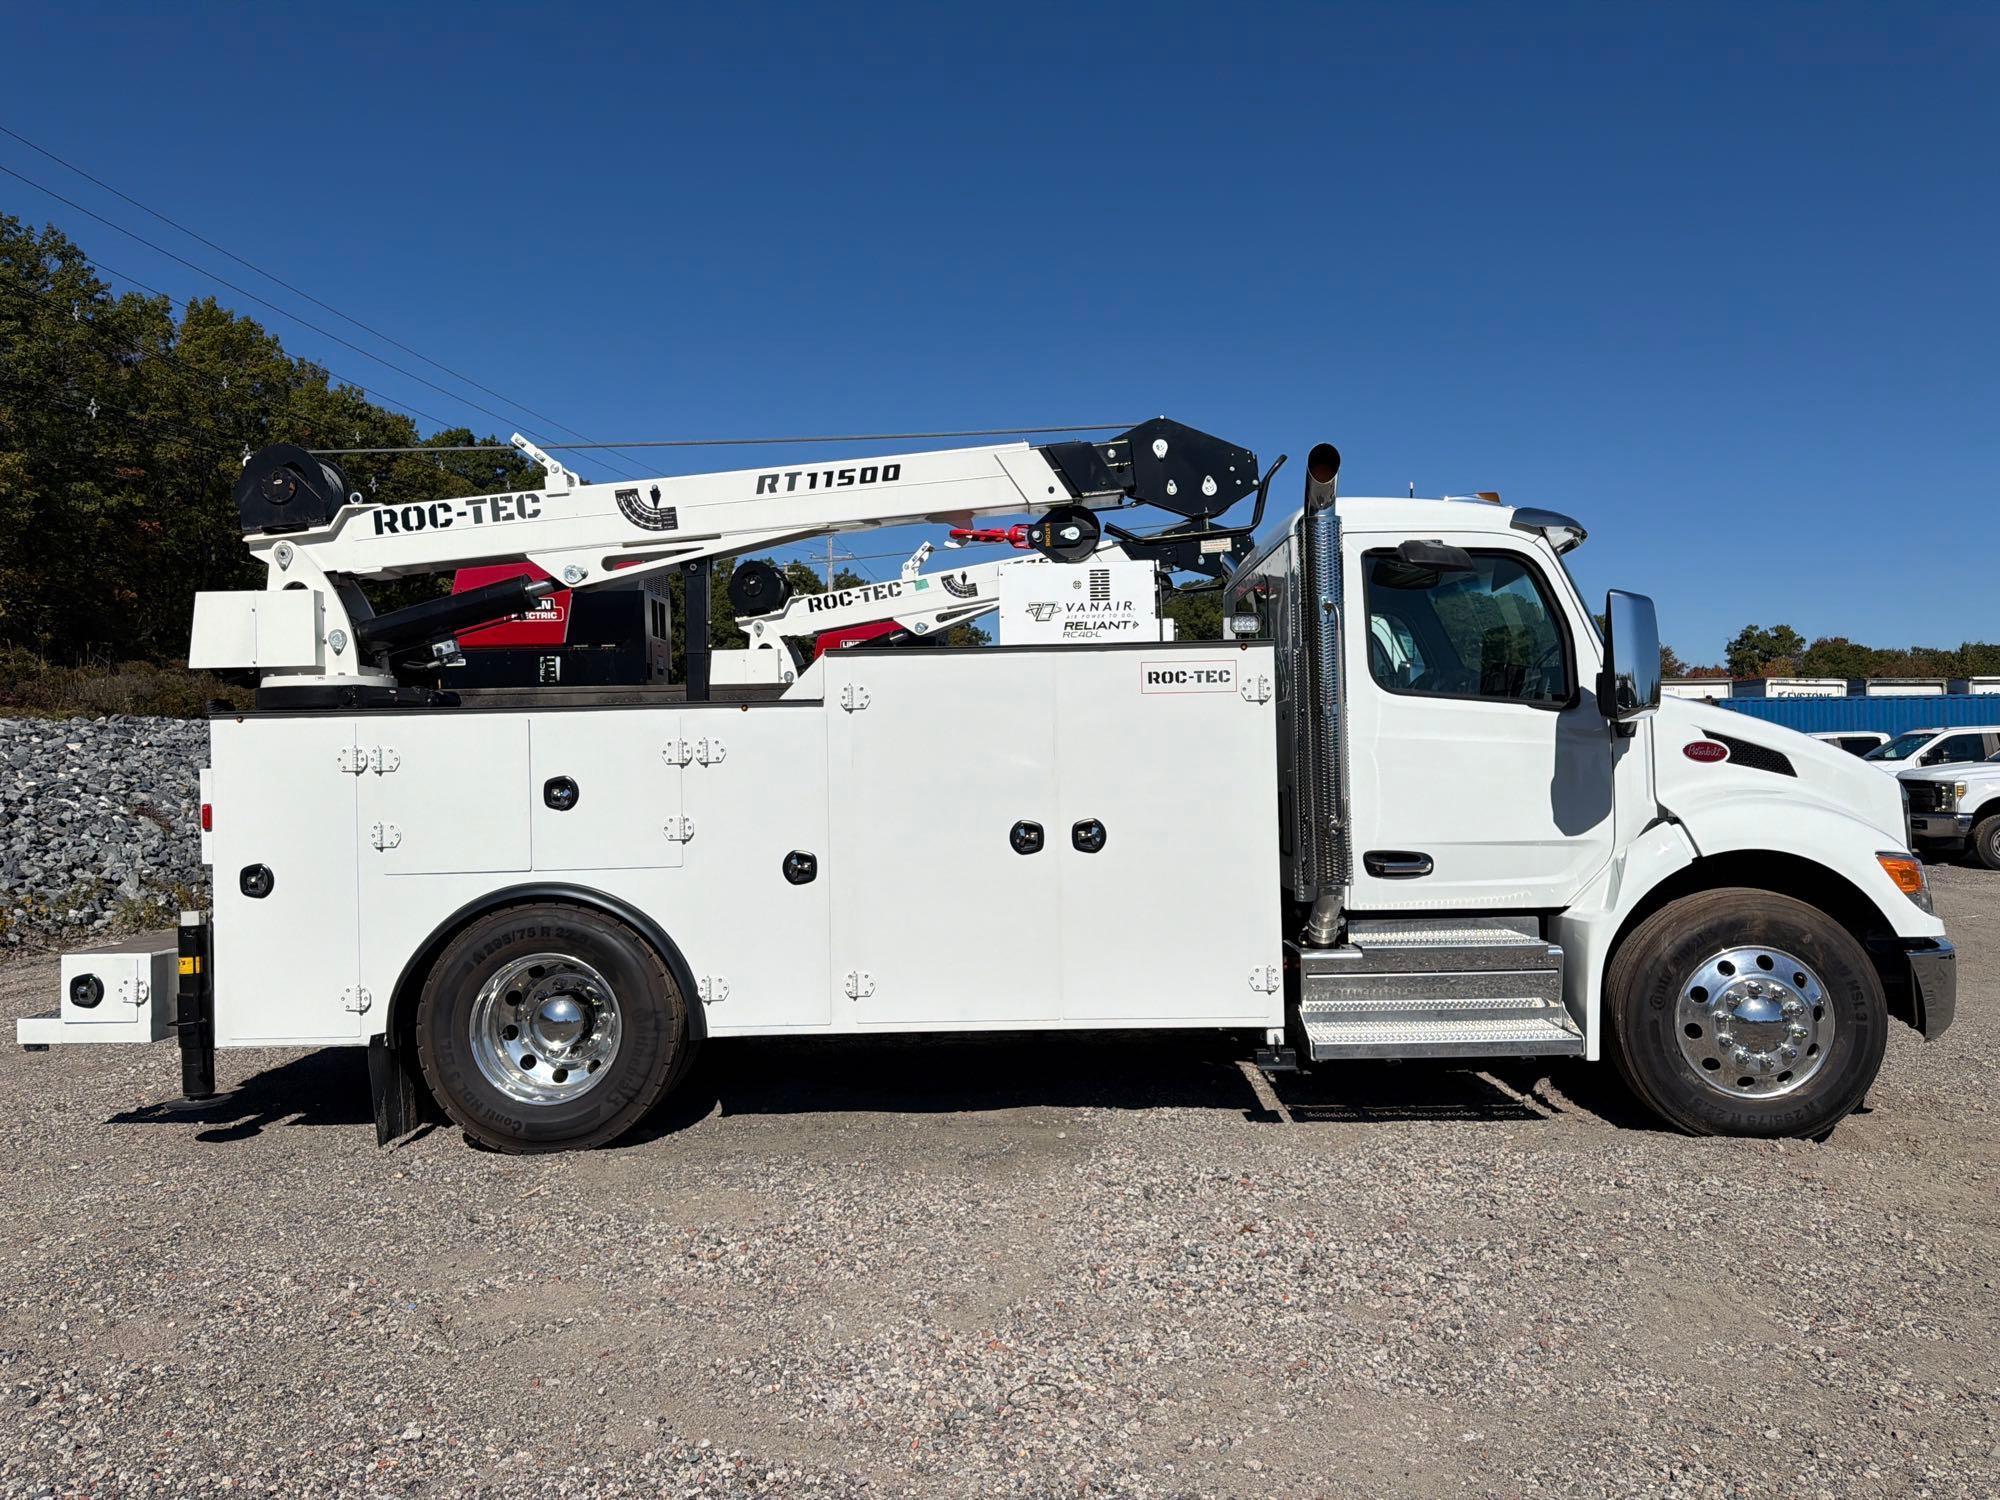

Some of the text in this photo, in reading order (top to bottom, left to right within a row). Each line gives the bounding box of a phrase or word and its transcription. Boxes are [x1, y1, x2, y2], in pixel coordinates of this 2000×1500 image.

[756, 464, 901, 495] RT11500
[373, 493, 542, 536] ROC-TEC
[808, 582, 902, 613] ROC-TEC
[1066, 601, 1132, 612] VANAIR
[1064, 620, 1131, 631] RELIANT
[1147, 669, 1231, 684] ROC-TEC
